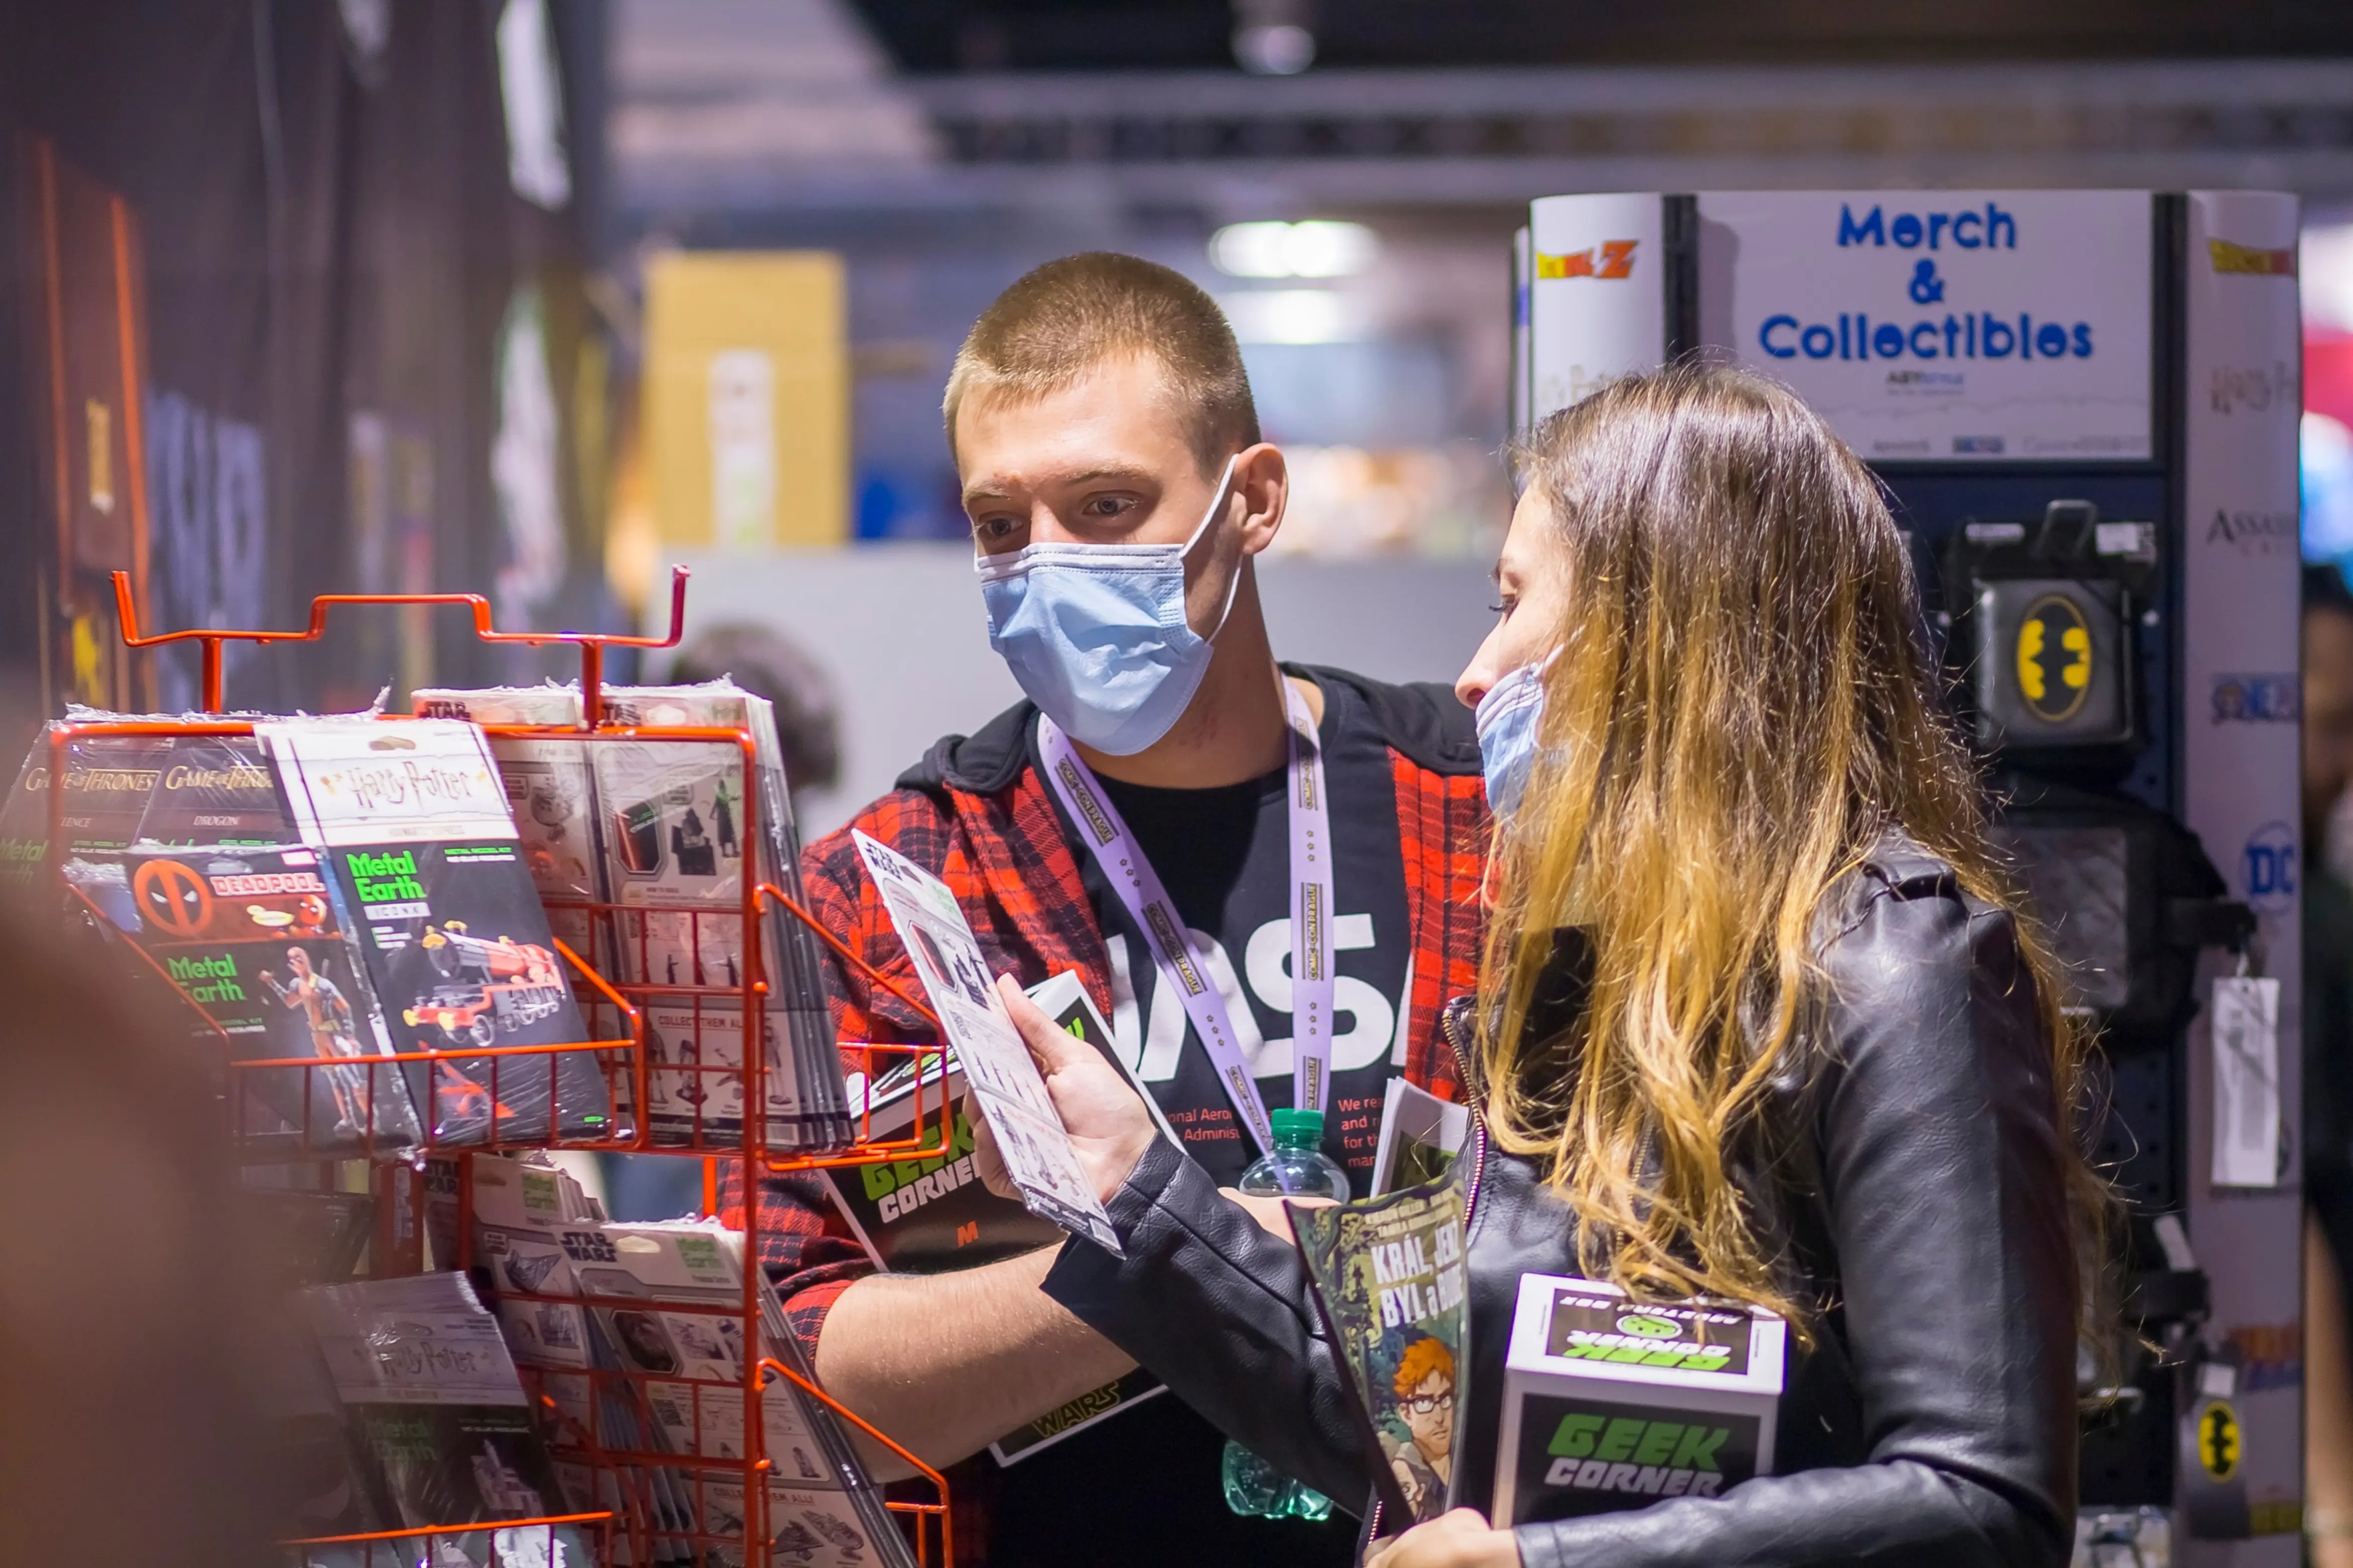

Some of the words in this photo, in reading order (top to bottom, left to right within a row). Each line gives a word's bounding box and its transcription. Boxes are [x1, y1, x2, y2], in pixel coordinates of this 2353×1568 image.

[1837, 202, 2017, 250] Merch
[1908, 257, 1945, 305] &
[1760, 312, 2094, 361] Collectibles
[82, 768, 162, 792] THRONES
[402, 761, 473, 813] Potter
[347, 850, 417, 877] Metal
[2247, 845, 2296, 895] DC
[210, 872, 326, 896] DEADPOOL
[354, 875, 427, 902] Earth
[1307, 883, 1318, 921] PRAGUE
[167, 954, 238, 979] Metal
[1338, 1099, 1360, 1112] We
[1341, 1115, 1367, 1131] and
[1344, 1136, 1363, 1149] for
[560, 1232, 613, 1246] STAR
[958, 1220, 978, 1247] M
[563, 1246, 617, 1262] WARS
[1031, 1380, 1121, 1438] WARS
[1547, 1413, 1731, 1472] GEEK
[1544, 1458, 1724, 1497] CORNER
